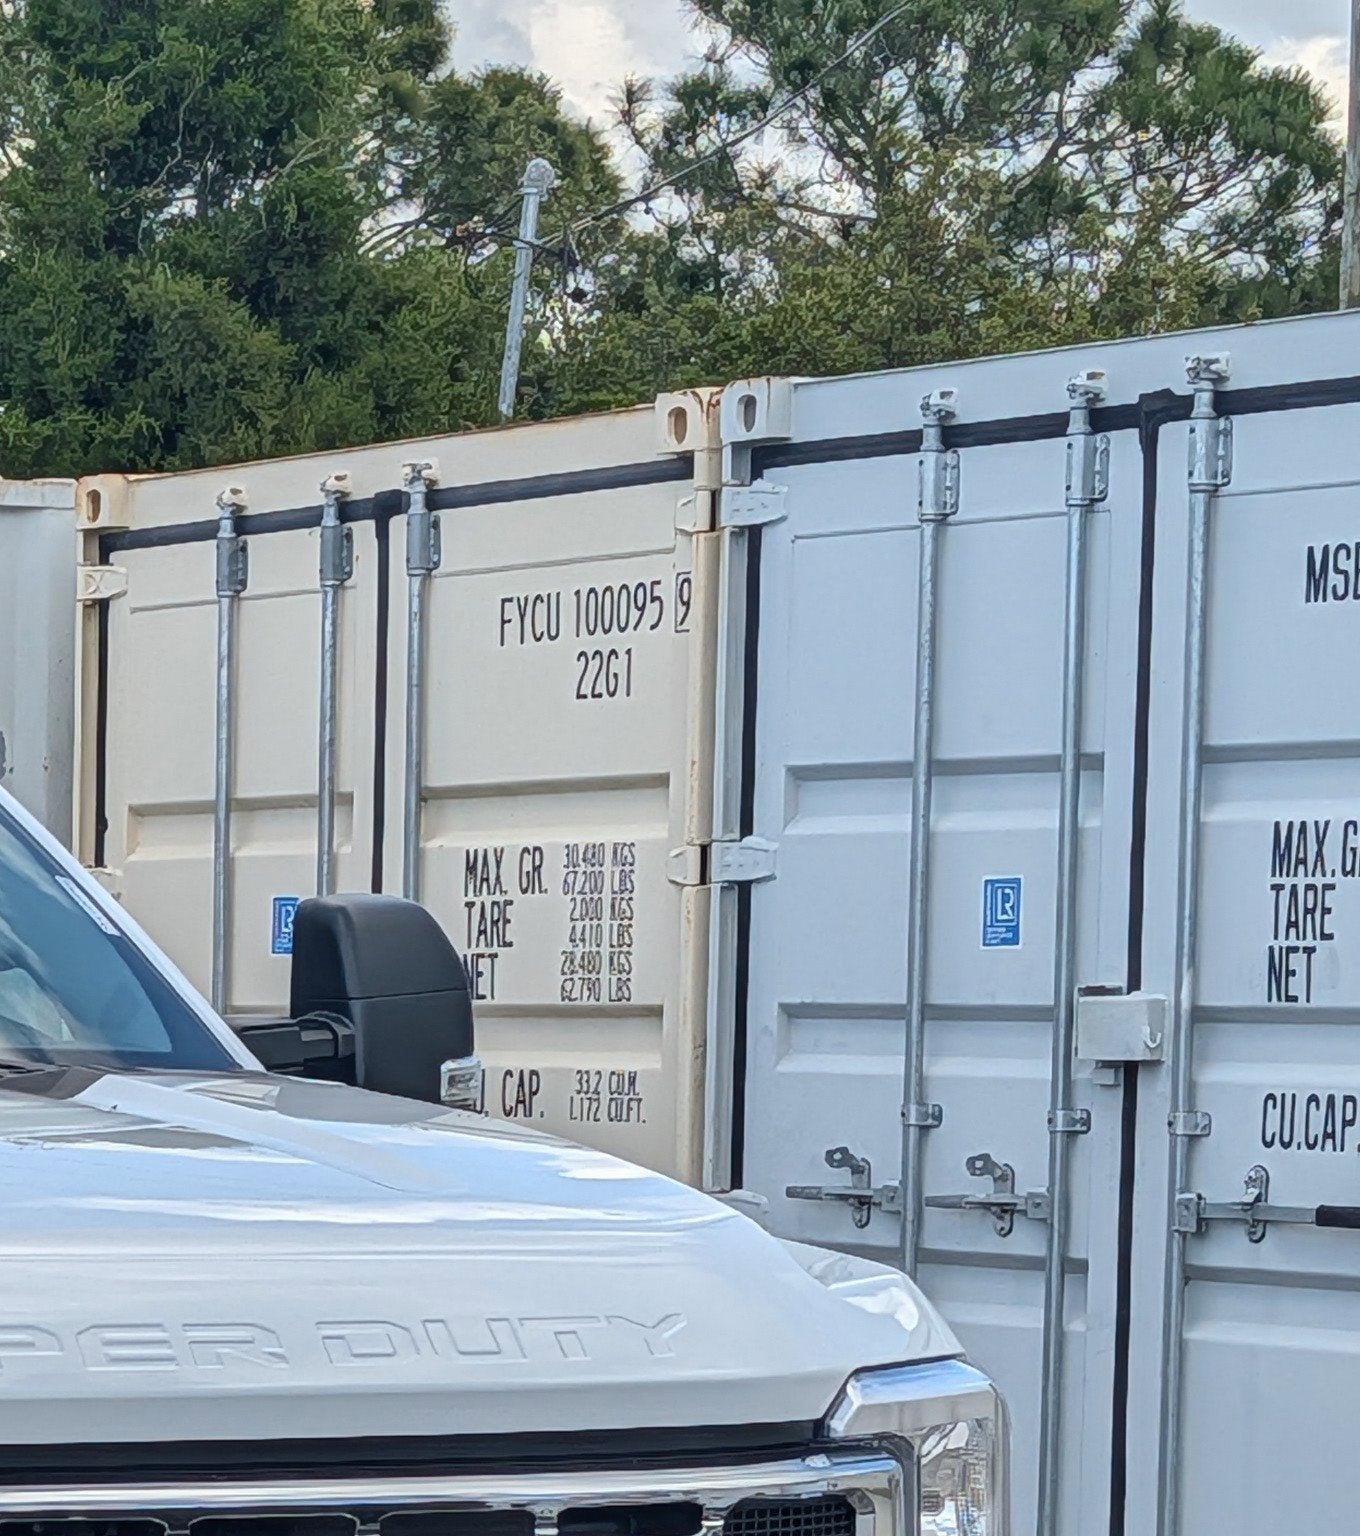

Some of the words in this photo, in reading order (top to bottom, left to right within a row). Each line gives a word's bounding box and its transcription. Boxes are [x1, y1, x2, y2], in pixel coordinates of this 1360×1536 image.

[500, 591, 561, 647] FYCU
[574, 579, 664, 638] 100095
[678, 576, 692, 627] 9
[576, 647, 633, 700] 22G1
[464, 846, 508, 898] MAX.
[518, 845, 548, 896] GR.
[611, 842, 636, 868] KGS
[1270, 819, 1360, 878] MAX.G
[610, 869, 635, 895] LBS
[464, 898, 514, 949] TARE
[608, 896, 634, 922] KGS
[608, 922, 634, 948] LBS
[1270, 882, 1336, 941] TARE
[608, 949, 633, 976] KGS
[1267, 944, 1317, 1004] NET
[608, 976, 632, 1003] LBS
[501, 1068, 545, 1119] CAP.
[314, 1312, 688, 1368] DUTY
